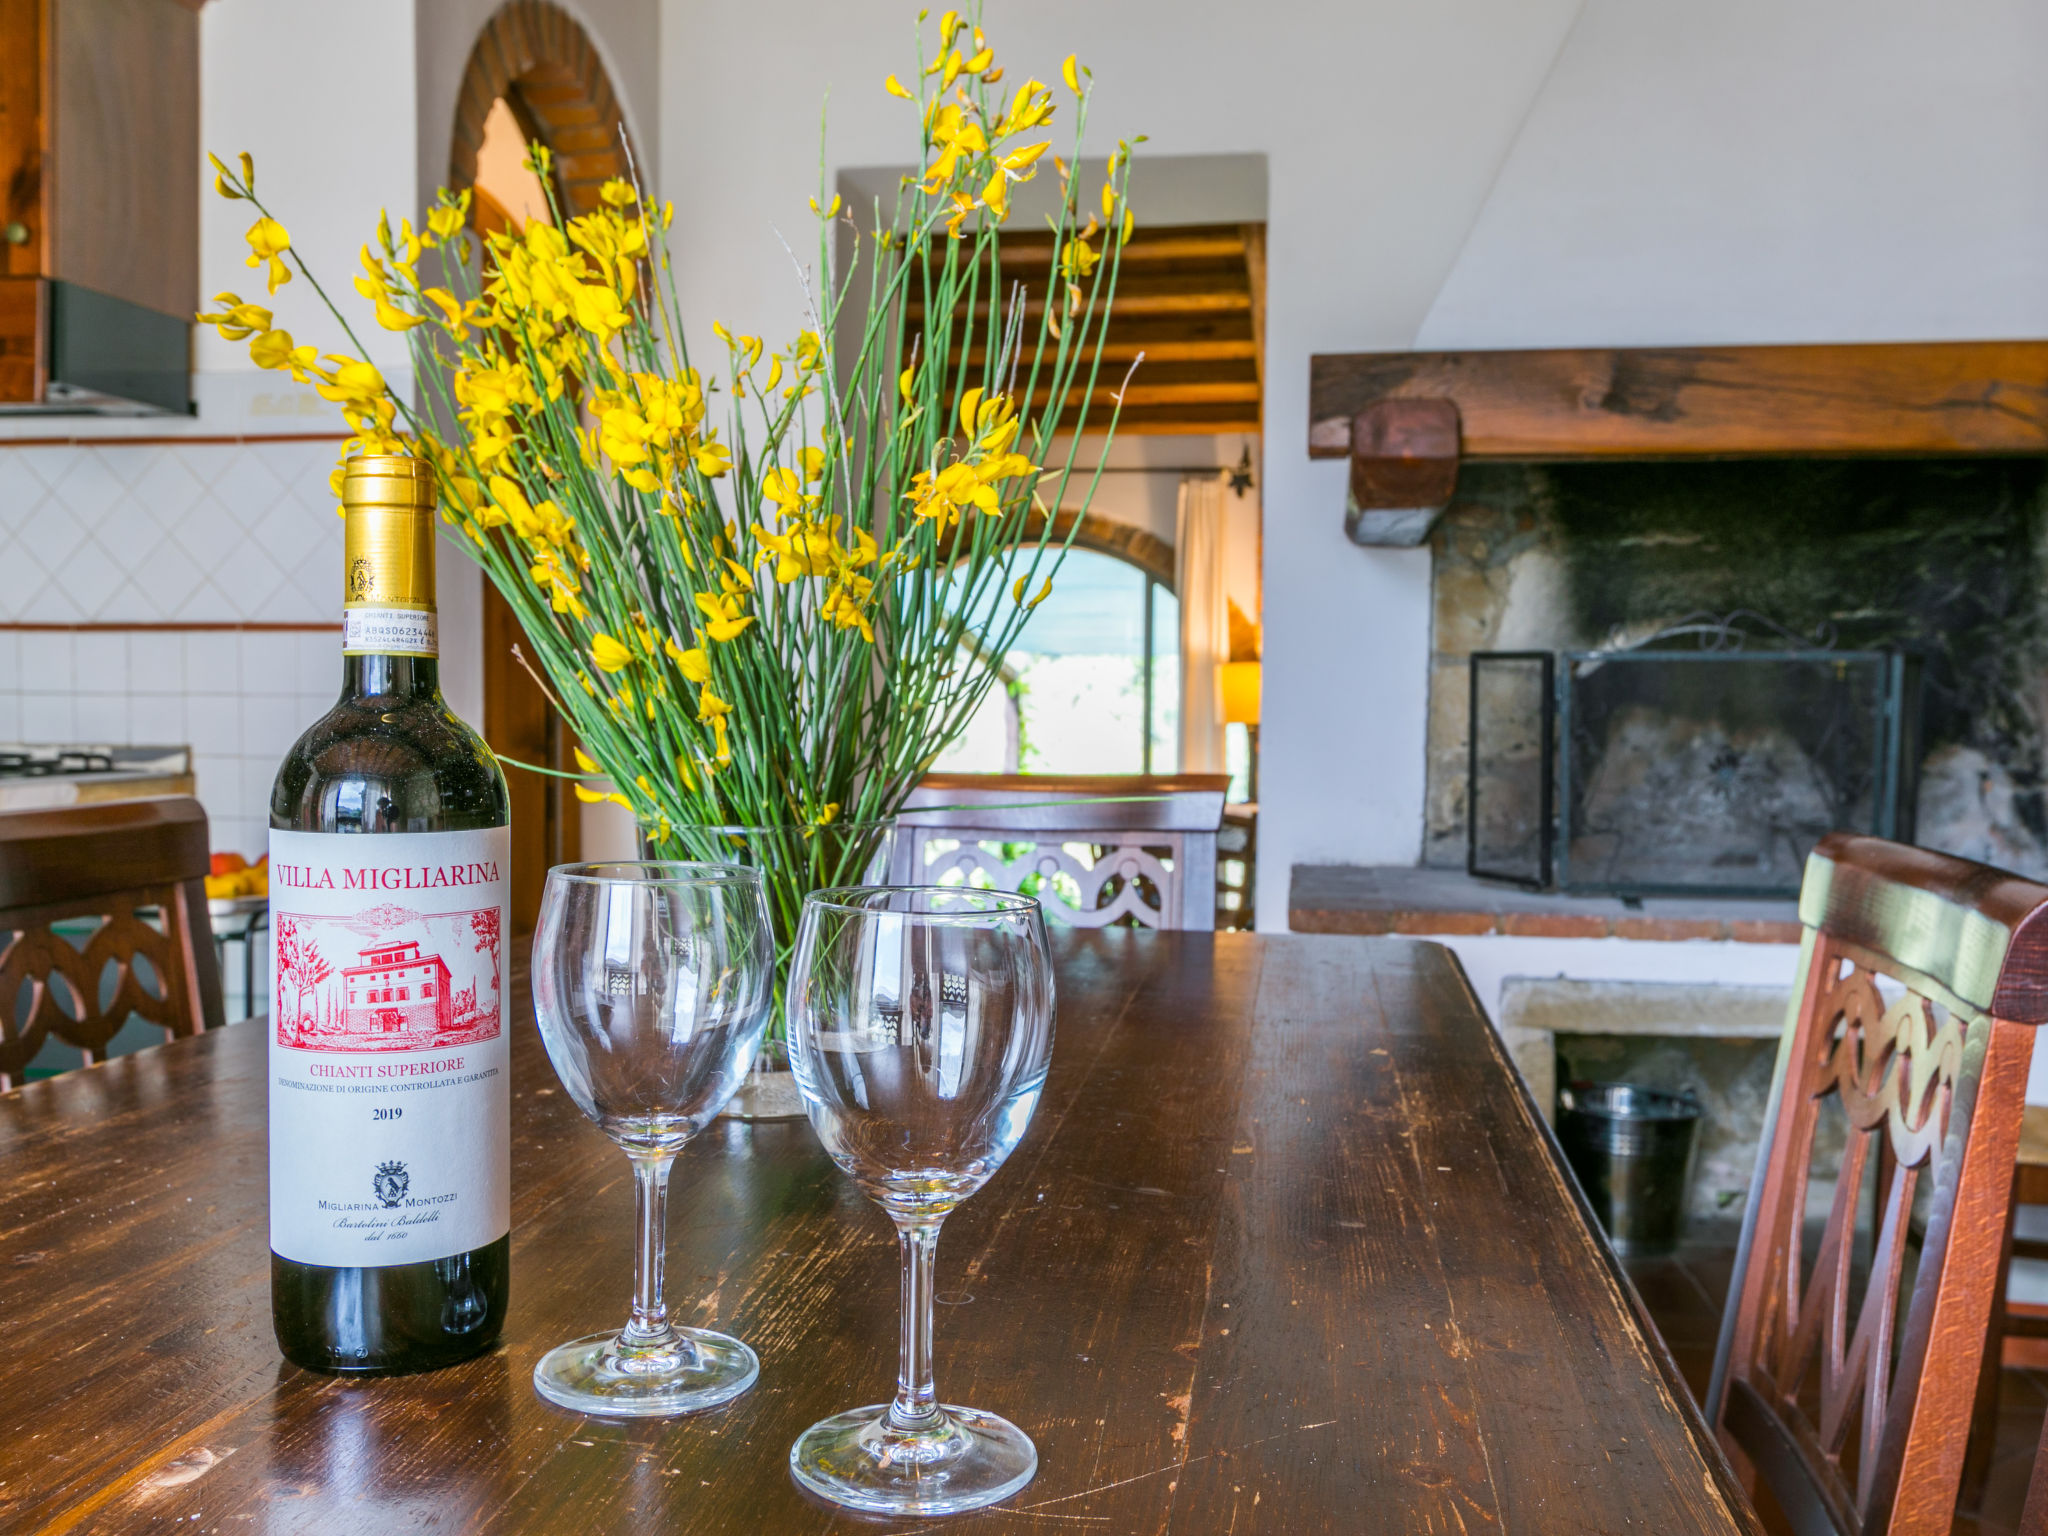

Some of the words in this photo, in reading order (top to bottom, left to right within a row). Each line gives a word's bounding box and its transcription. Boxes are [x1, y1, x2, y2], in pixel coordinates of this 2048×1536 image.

[397, 613, 430, 622] SUPERIORE
[277, 864, 336, 889] VILLA
[342, 860, 500, 890] MIGLIARINA
[310, 1064, 373, 1078] CHIANTI
[377, 1057, 465, 1078] SUPERIORE
[278, 1077, 334, 1093] DENOMINAZIONE
[336, 1085, 346, 1094] DI
[347, 1085, 389, 1094] ORIGINE
[390, 1079, 456, 1093] CONTROLLATA
[457, 1076, 463, 1084] E
[463, 1067, 499, 1083] GARANTITA
[373, 1107, 403, 1121] 2019
[318, 1199, 379, 1211] MIGLIARINA
[405, 1192, 458, 1208] MONTOZZI
[332, 1216, 388, 1229] Bartolini
[390, 1210, 441, 1227] Baldelli
[364, 1231, 385, 1241] dal
[386, 1231, 408, 1241] 1660
